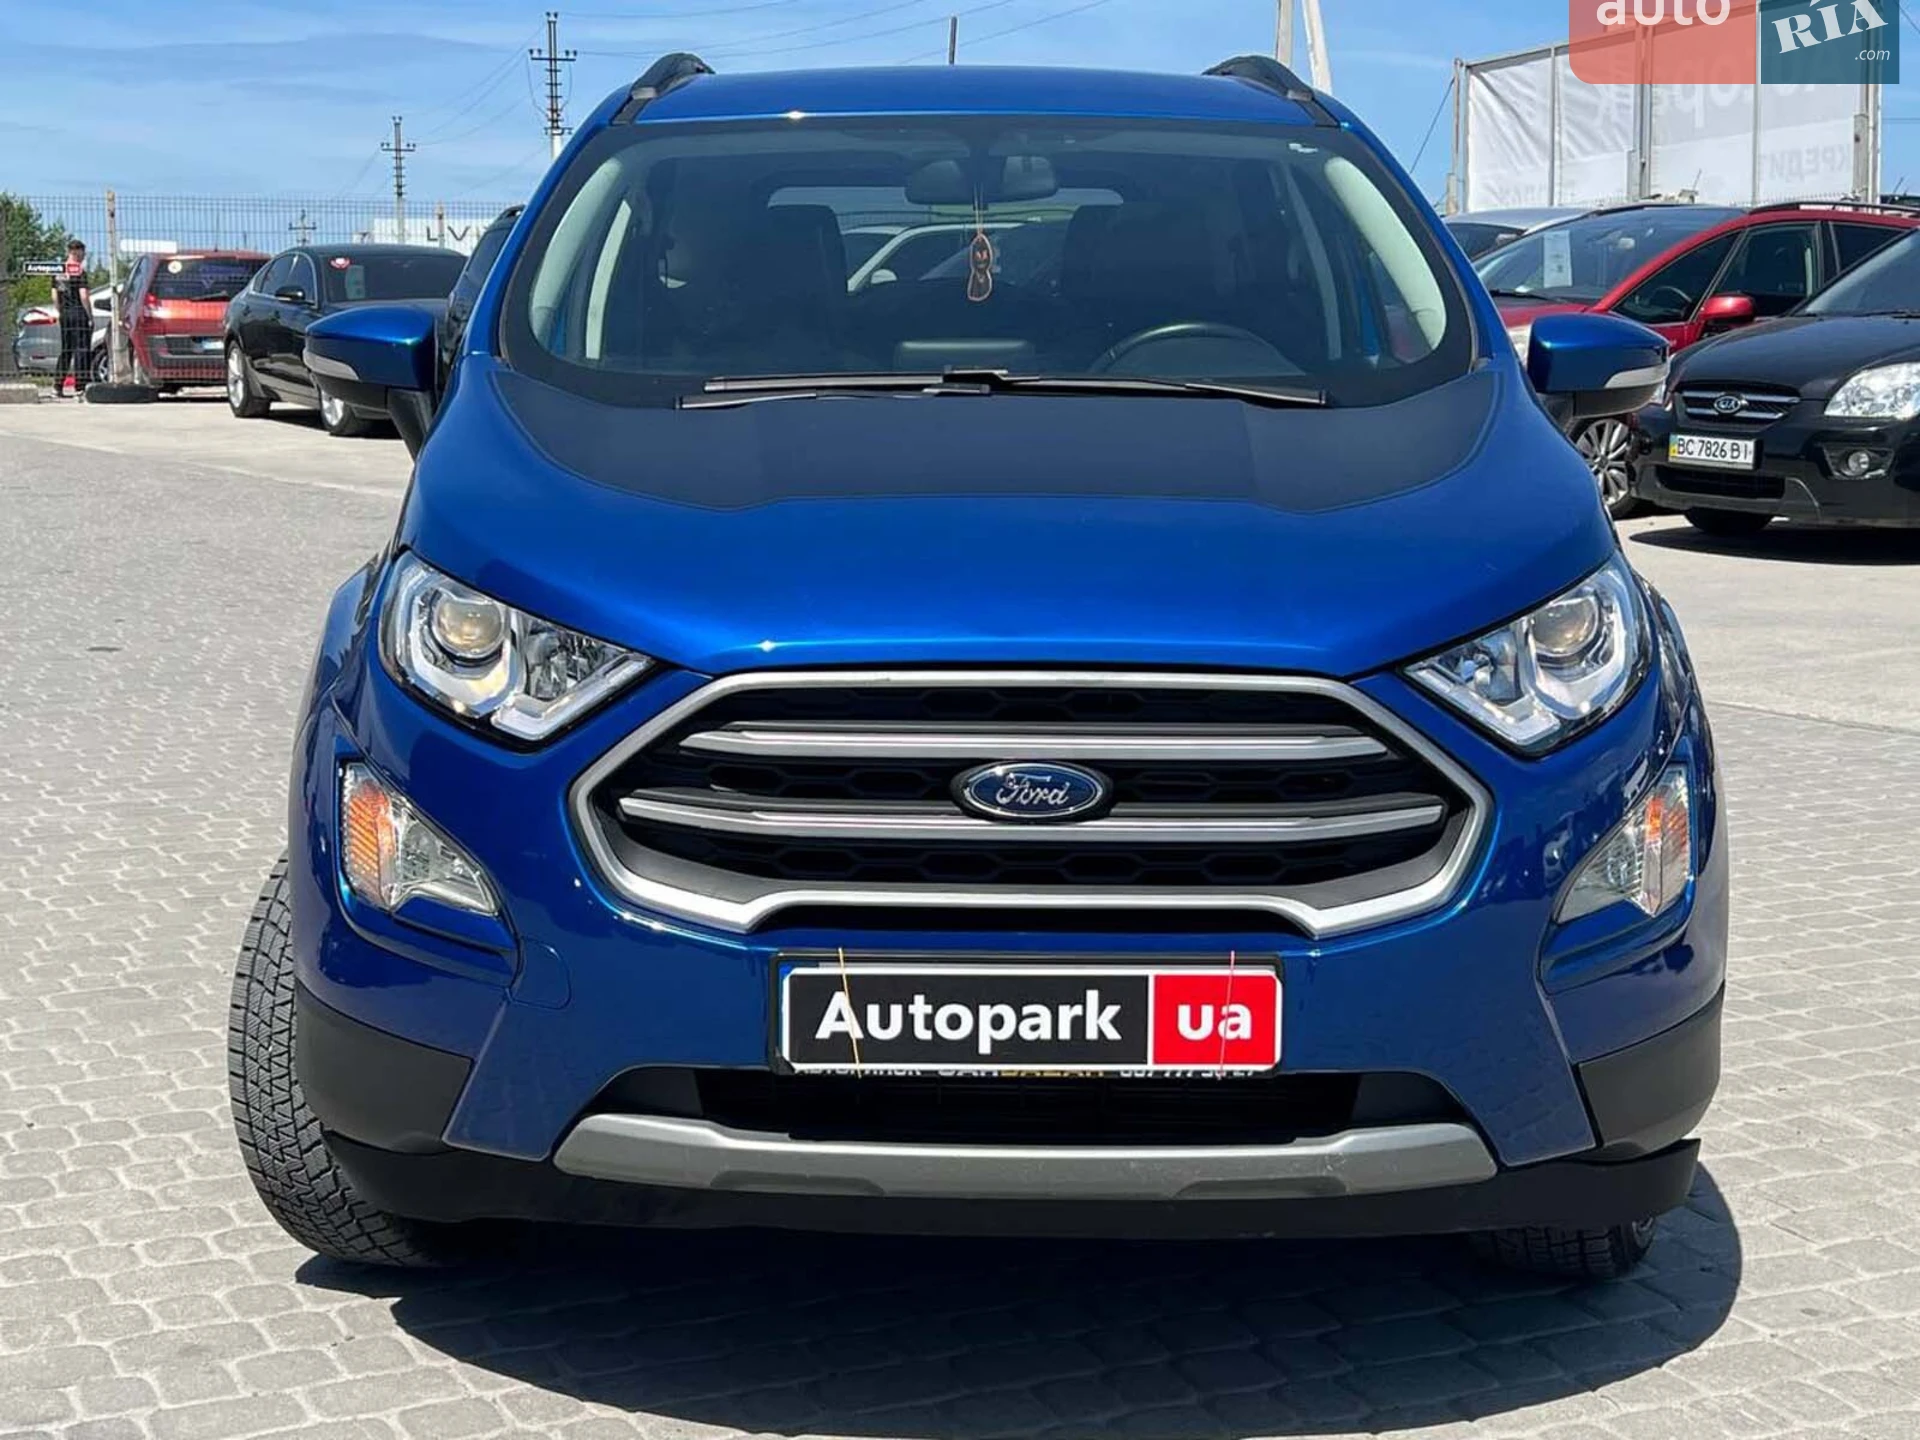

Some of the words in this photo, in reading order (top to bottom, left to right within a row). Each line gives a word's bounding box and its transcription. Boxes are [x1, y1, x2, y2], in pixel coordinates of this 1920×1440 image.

[1677, 437, 1694, 456] BC
[1698, 439, 1727, 459] 7826
[996, 772, 1070, 806] Ford
[815, 989, 1122, 1055] Autopark
[1177, 1003, 1252, 1041] ua
